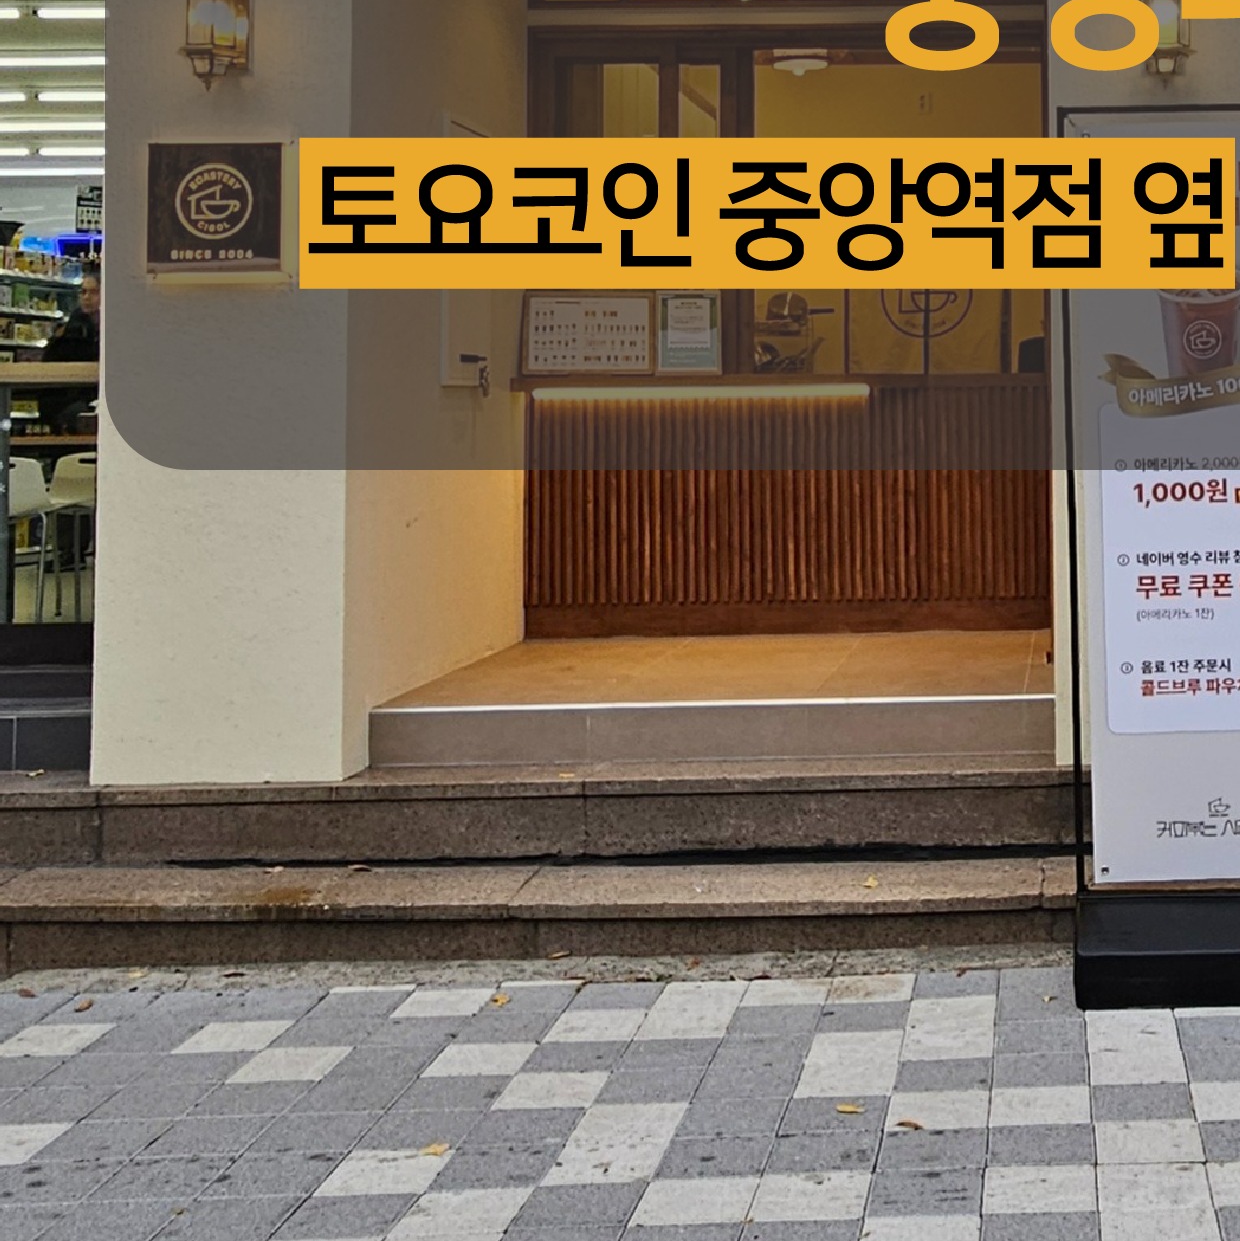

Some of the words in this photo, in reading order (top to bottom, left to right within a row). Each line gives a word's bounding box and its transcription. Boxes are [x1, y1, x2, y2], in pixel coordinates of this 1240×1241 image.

[1129, 381, 1213, 406] 아메리카노
[1133, 458, 1199, 472] 아메리카노
[1133, 478, 1228, 509] 1,000원
[1136, 552, 1175, 567] 네이버
[1205, 550, 1231, 564] 리뷰
[1136, 575, 1182, 600] 무료
[1188, 573, 1234, 598] 쿠폰
[1141, 660, 1166, 674] 음료
[1193, 658, 1232, 673] 주문시
